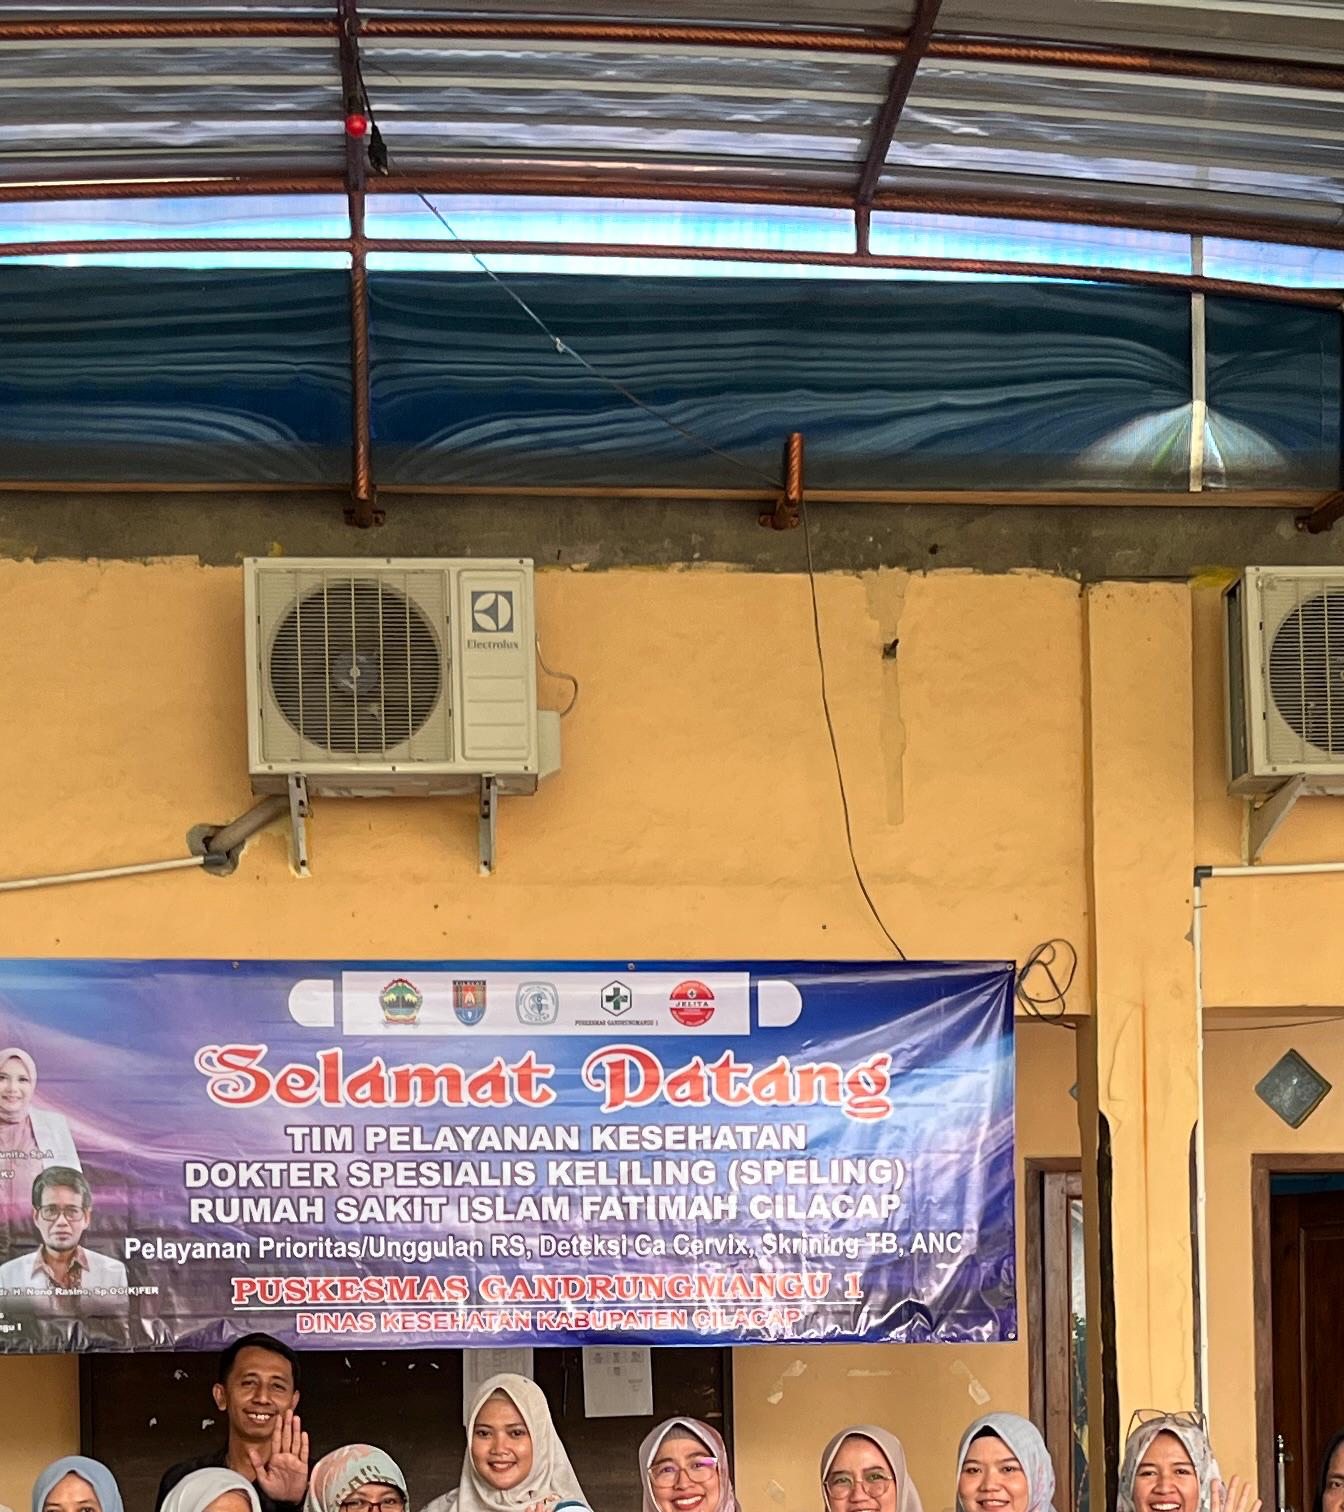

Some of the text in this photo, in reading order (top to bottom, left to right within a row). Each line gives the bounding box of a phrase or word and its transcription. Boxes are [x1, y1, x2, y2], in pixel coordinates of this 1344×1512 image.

[466, 639, 520, 650] Electrolux
[195, 1043, 894, 1122] Selamat Datang
[286, 1125, 806, 1151] TIM PELAYANAN KESEHATAN
[185, 1159, 904, 1191] DOKTER SPESIALIS KELILING (SPELING)
[191, 1195, 901, 1223] RUMAH SAKIT ISLAM FATIMAH CILACAP
[125, 1232, 962, 1264] Pelayanan Prioritas/Unggulan RS, Deteksi Ca Cervix, Skrining TB, ANC
[26, 1287, 52, 1296] Nono
[231, 1272, 864, 1305] PUSKESMAS GANDRUNGMANGU 1
[297, 1307, 802, 1334] DINAS KESEHATAN KABUPATEN CILACAP
